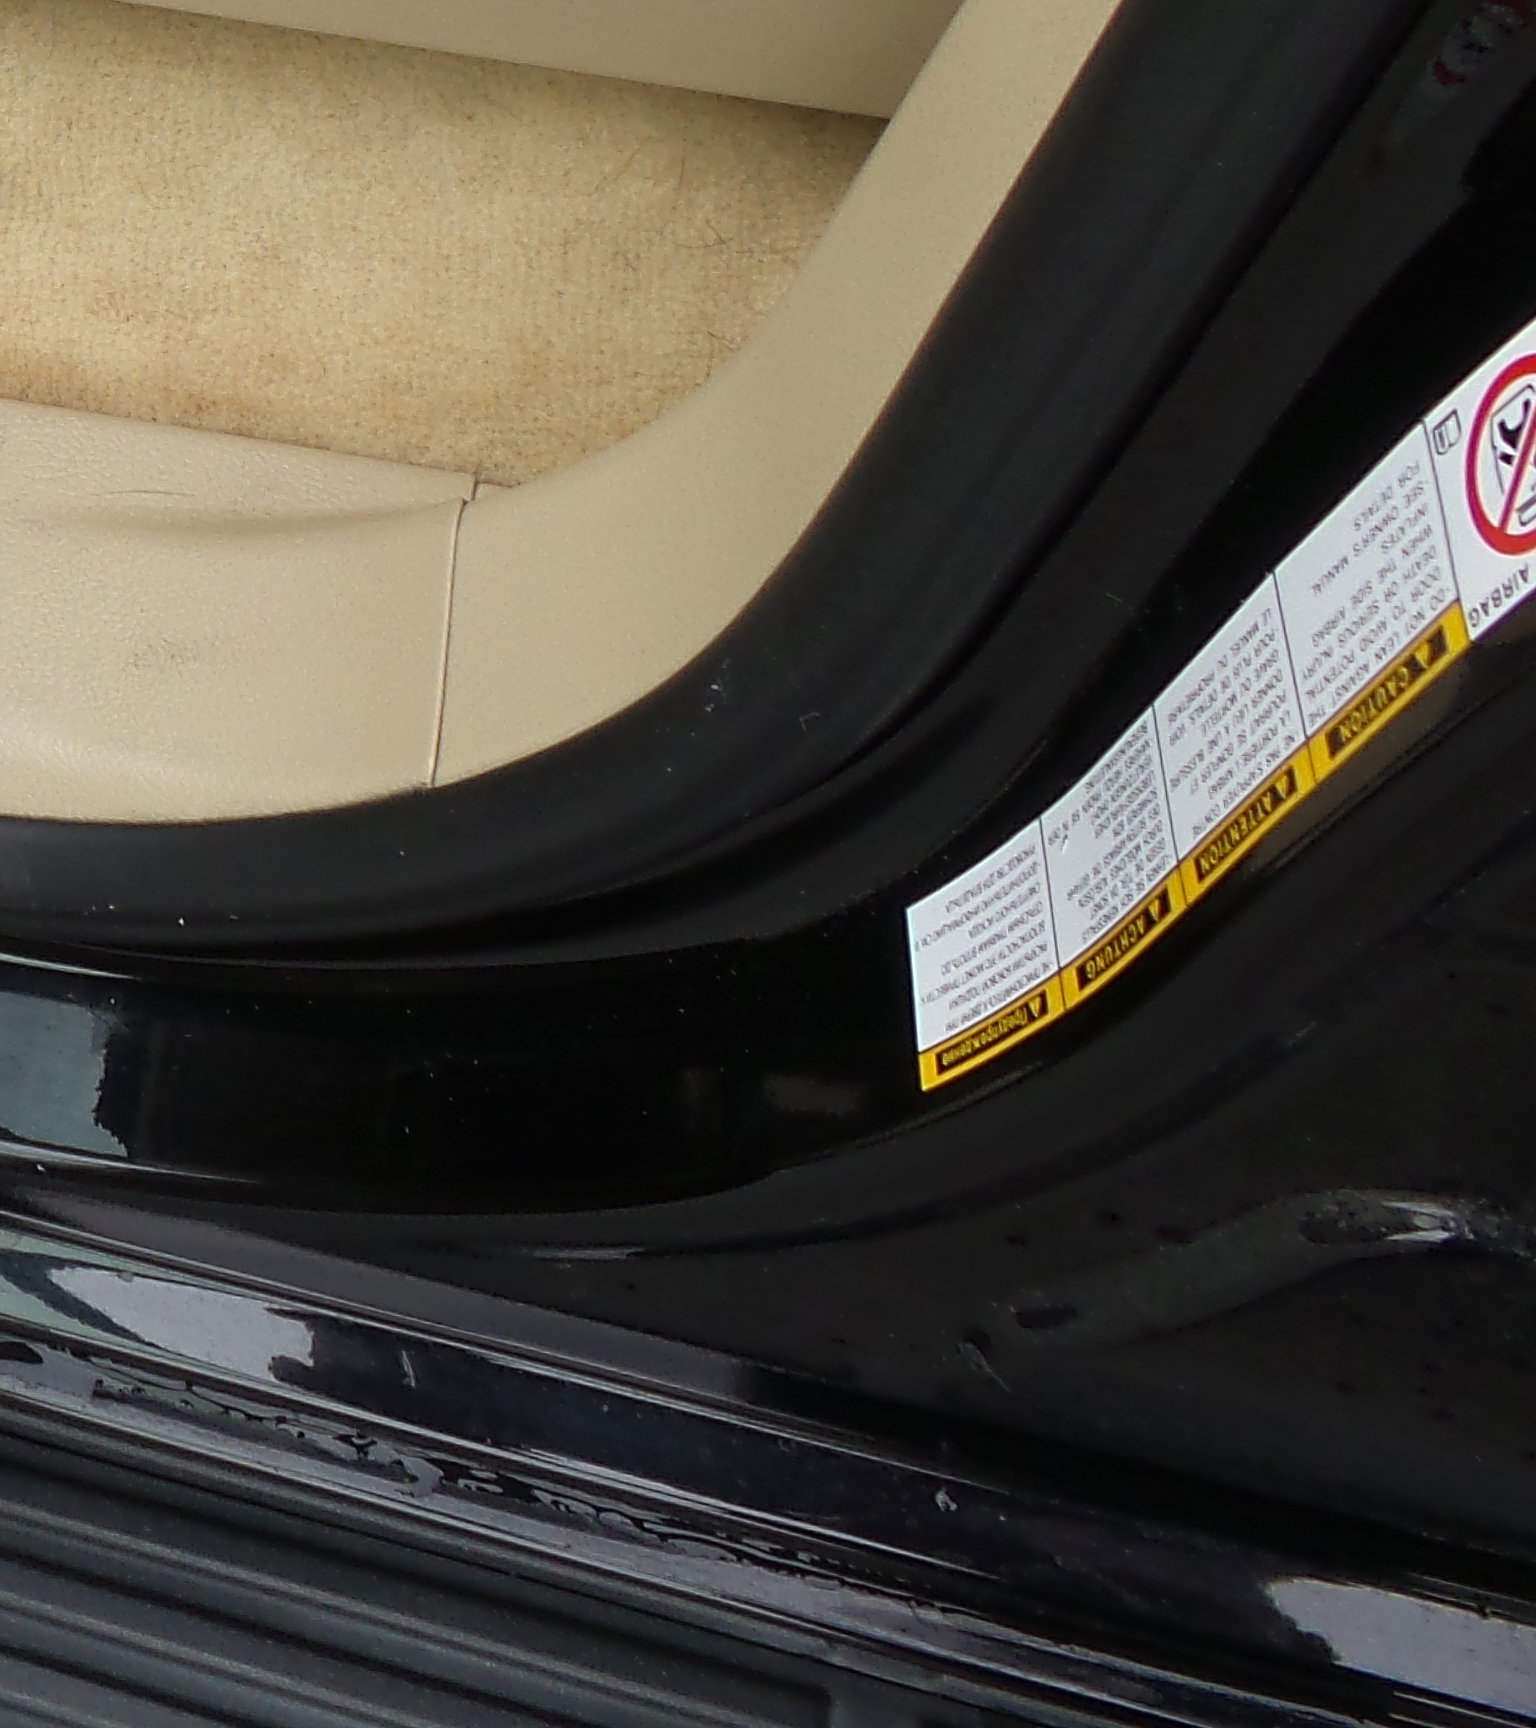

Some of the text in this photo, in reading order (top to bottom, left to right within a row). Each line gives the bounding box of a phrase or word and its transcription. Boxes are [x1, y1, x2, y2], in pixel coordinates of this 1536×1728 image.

[1468, 562, 1530, 628] AIRBAG
[1340, 667, 1408, 740] CAUTION
[1200, 792, 1271, 869] ATTENTION
[1086, 920, 1144, 978] ACHTUNG
